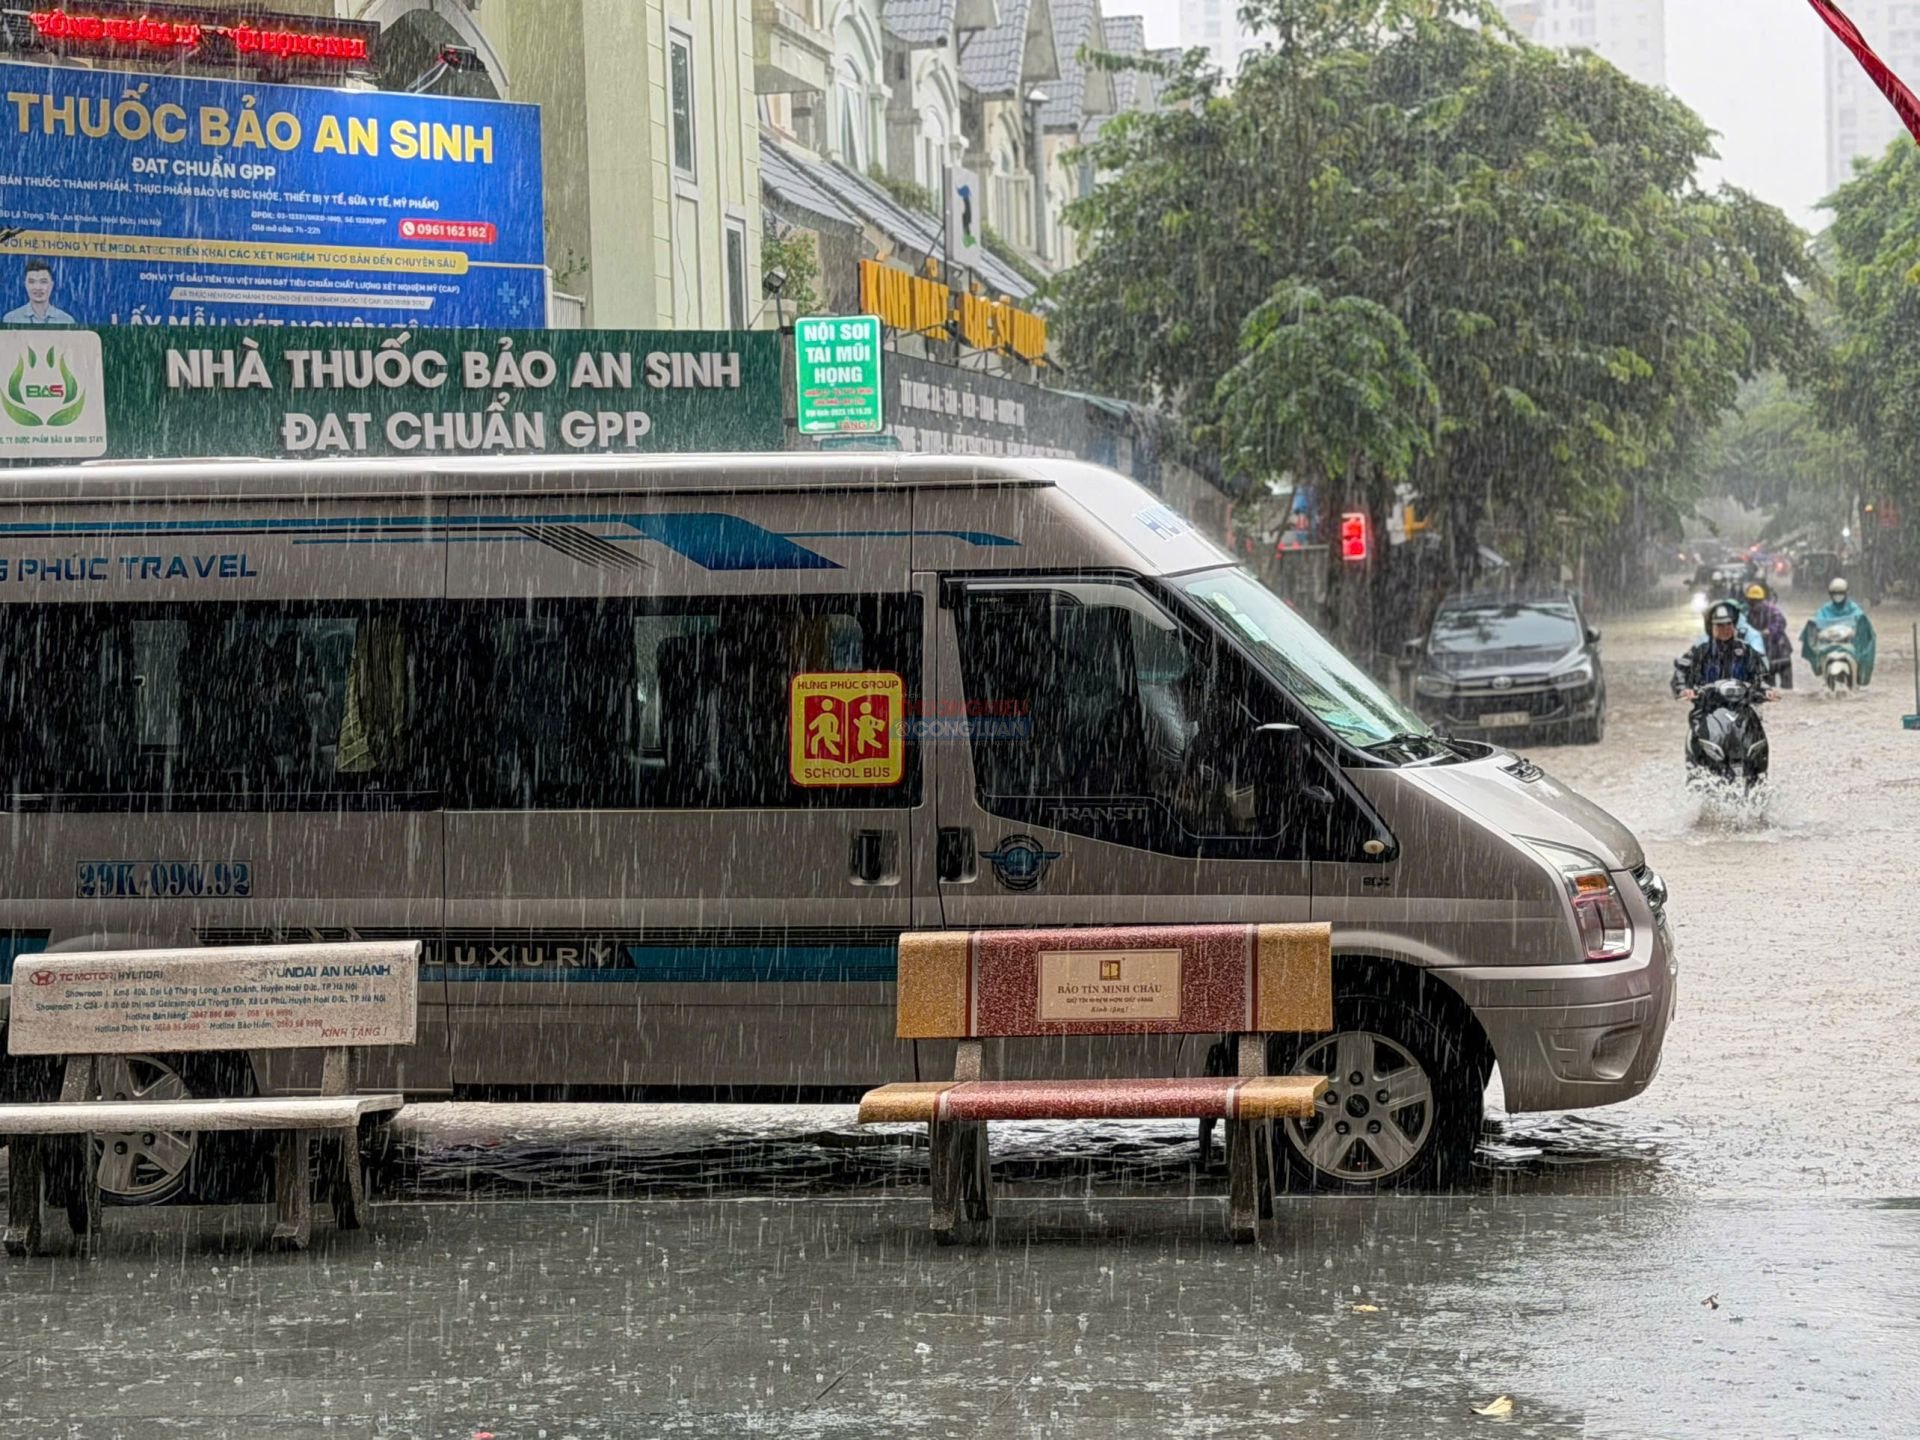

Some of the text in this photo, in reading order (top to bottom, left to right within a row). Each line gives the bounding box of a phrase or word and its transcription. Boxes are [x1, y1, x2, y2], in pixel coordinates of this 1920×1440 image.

[261, 31, 323, 57] HỌNG
[325, 36, 367, 59] NHI
[8, 83, 494, 164] THUỐC BẢO AN SINH
[132, 155, 276, 181] ĐẠT CHUẨN GPP
[24, 174, 60, 188] THUỐC
[63, 178, 98, 190] THÀNH
[135, 183, 161, 196] THỰC
[163, 182, 192, 196] PHẨM
[194, 185, 215, 197] BẢO
[216, 187, 229, 199] VỆ
[231, 187, 251, 199] SỨC
[283, 190, 311, 203] THIẾT
[312, 193, 322, 205] BỊ
[323, 194, 330, 204] Y
[348, 194, 368, 206] SỮA
[369, 197, 376, 207] Y
[393, 197, 407, 209] MỸ
[409, 196, 439, 211] PHẨM)
[417, 223, 487, 238] 0961 162 162
[83, 241, 91, 251] Y
[202, 247, 227, 258] KHAI
[229, 247, 250, 259] CÁC
[253, 248, 273, 260] XÉT
[275, 250, 315, 263] NGHIỆM
[373, 253, 393, 266] ĐẾN
[395, 256, 435, 268] CHUYÊN
[803, 321, 871, 345] NỘI SOI
[166, 332, 740, 389] NHÀ THUỐC BẢO AN SINH
[805, 342, 871, 364] TAI MŨI
[814, 366, 863, 387] HỌNG
[25, 384, 64, 398] BAS
[386, 392, 545, 450] CHUẨN
[561, 410, 651, 450] GPP
[18, 553, 108, 581] PHÚC
[119, 553, 257, 580] TRAVEL
[830, 678, 859, 690] PHÚC
[861, 680, 899, 689] GROUP
[804, 767, 890, 779] SCHOOL BUS
[425, 946, 612, 967] LUXURY
[59, 973, 73, 982] TC
[75, 971, 113, 981] MOTOR
[320, 963, 391, 978] AN KHÁNH
[65, 988, 103, 999] Showroom
[1057, 982, 1162, 994] BẢO TÍN MINH CHÂU
